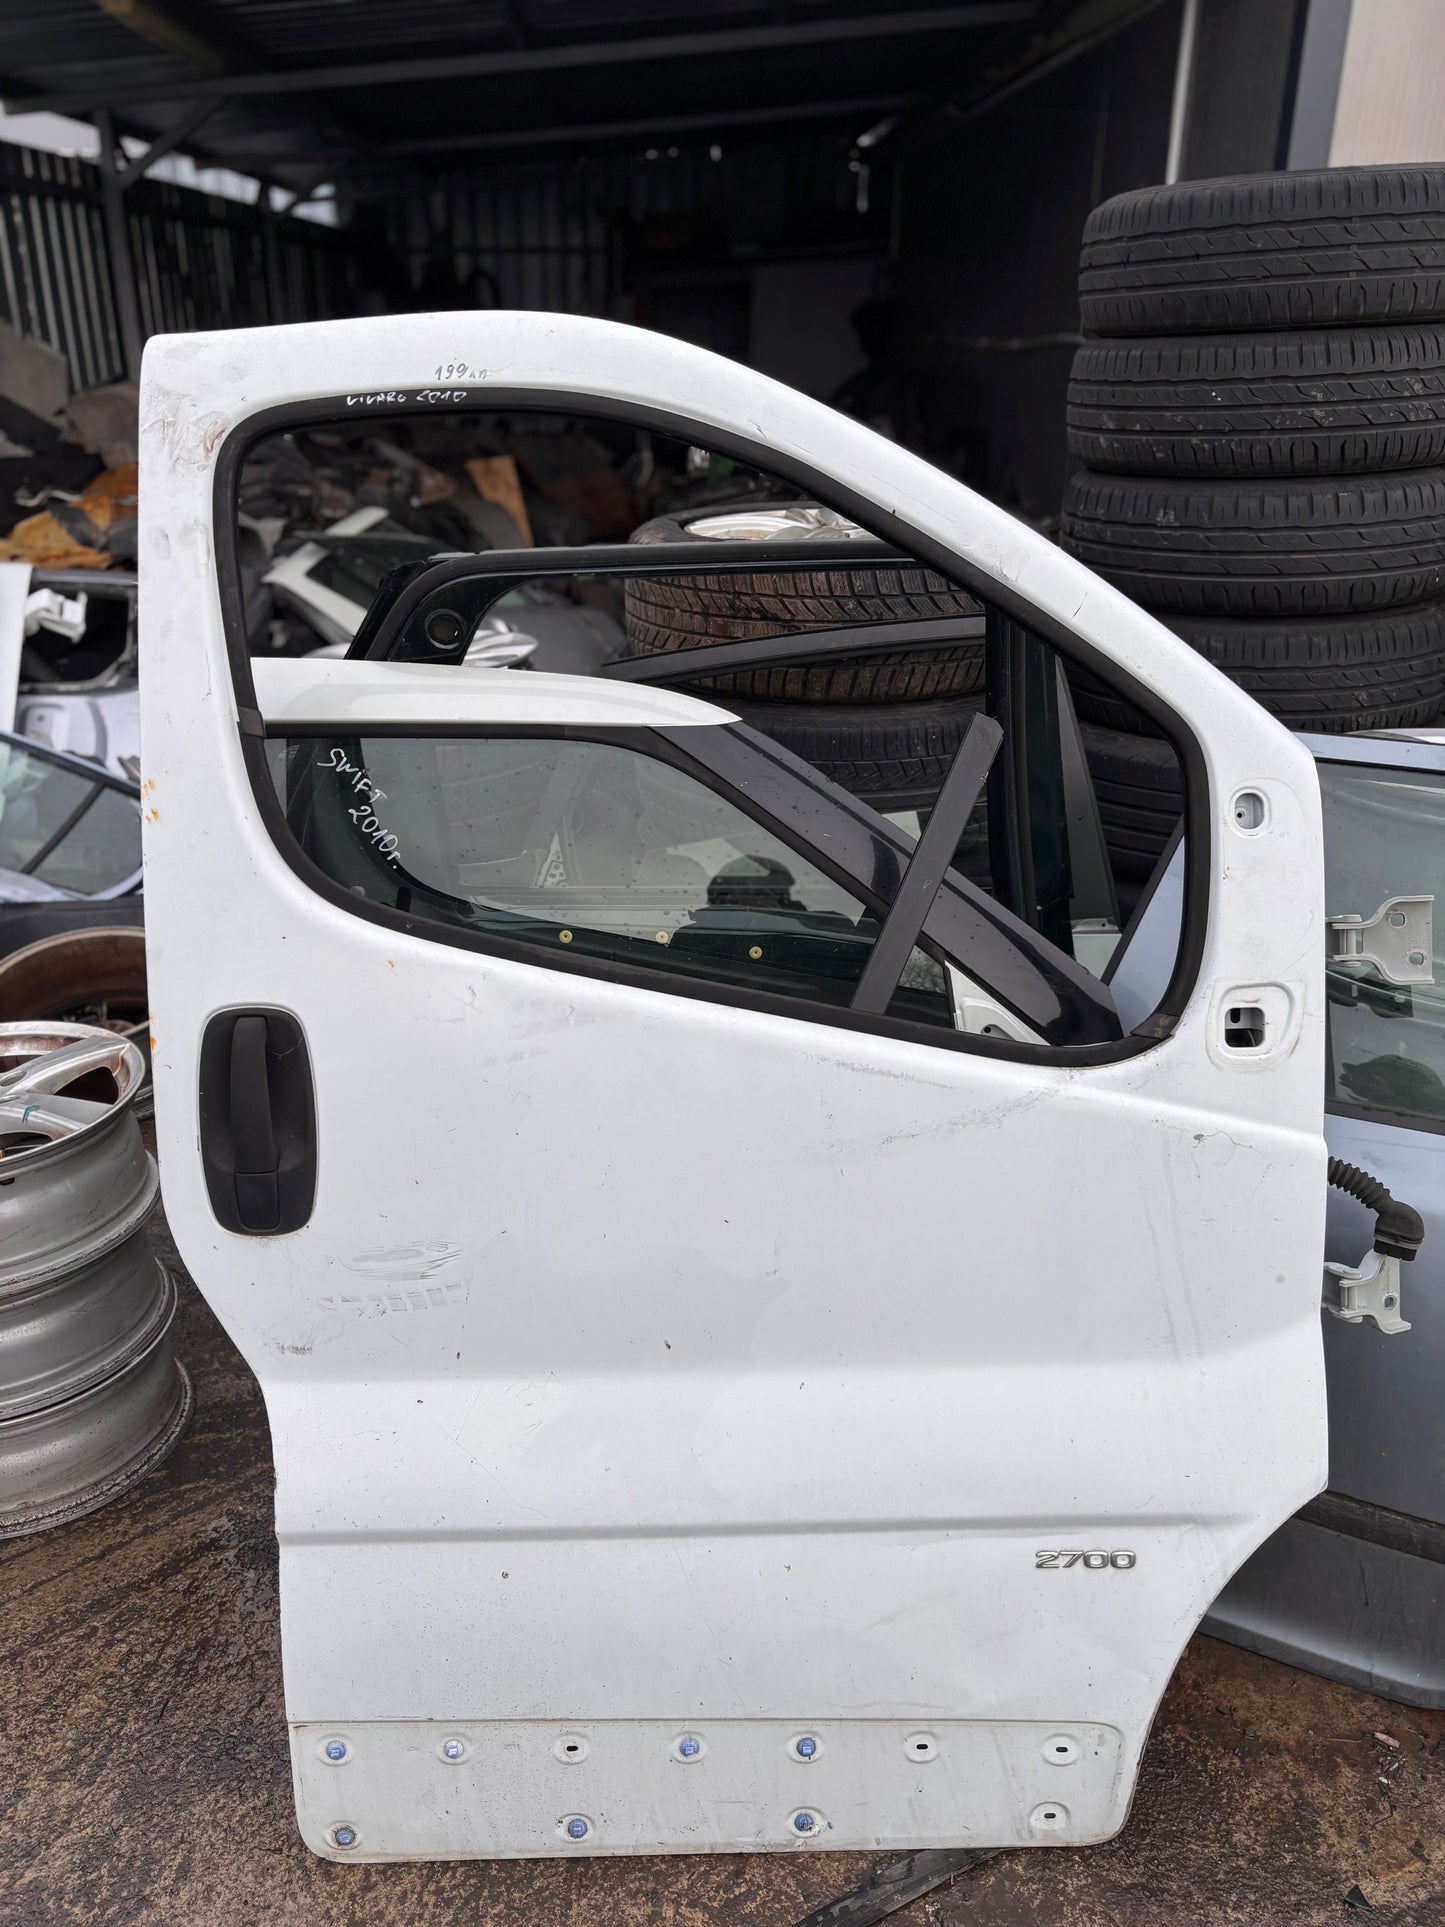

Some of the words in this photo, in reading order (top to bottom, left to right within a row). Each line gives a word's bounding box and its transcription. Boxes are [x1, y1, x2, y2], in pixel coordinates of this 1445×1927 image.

[416, 389, 467, 404] 2010
[317, 748, 388, 803] SWIFT
[1035, 1550, 1136, 1569] 2700
